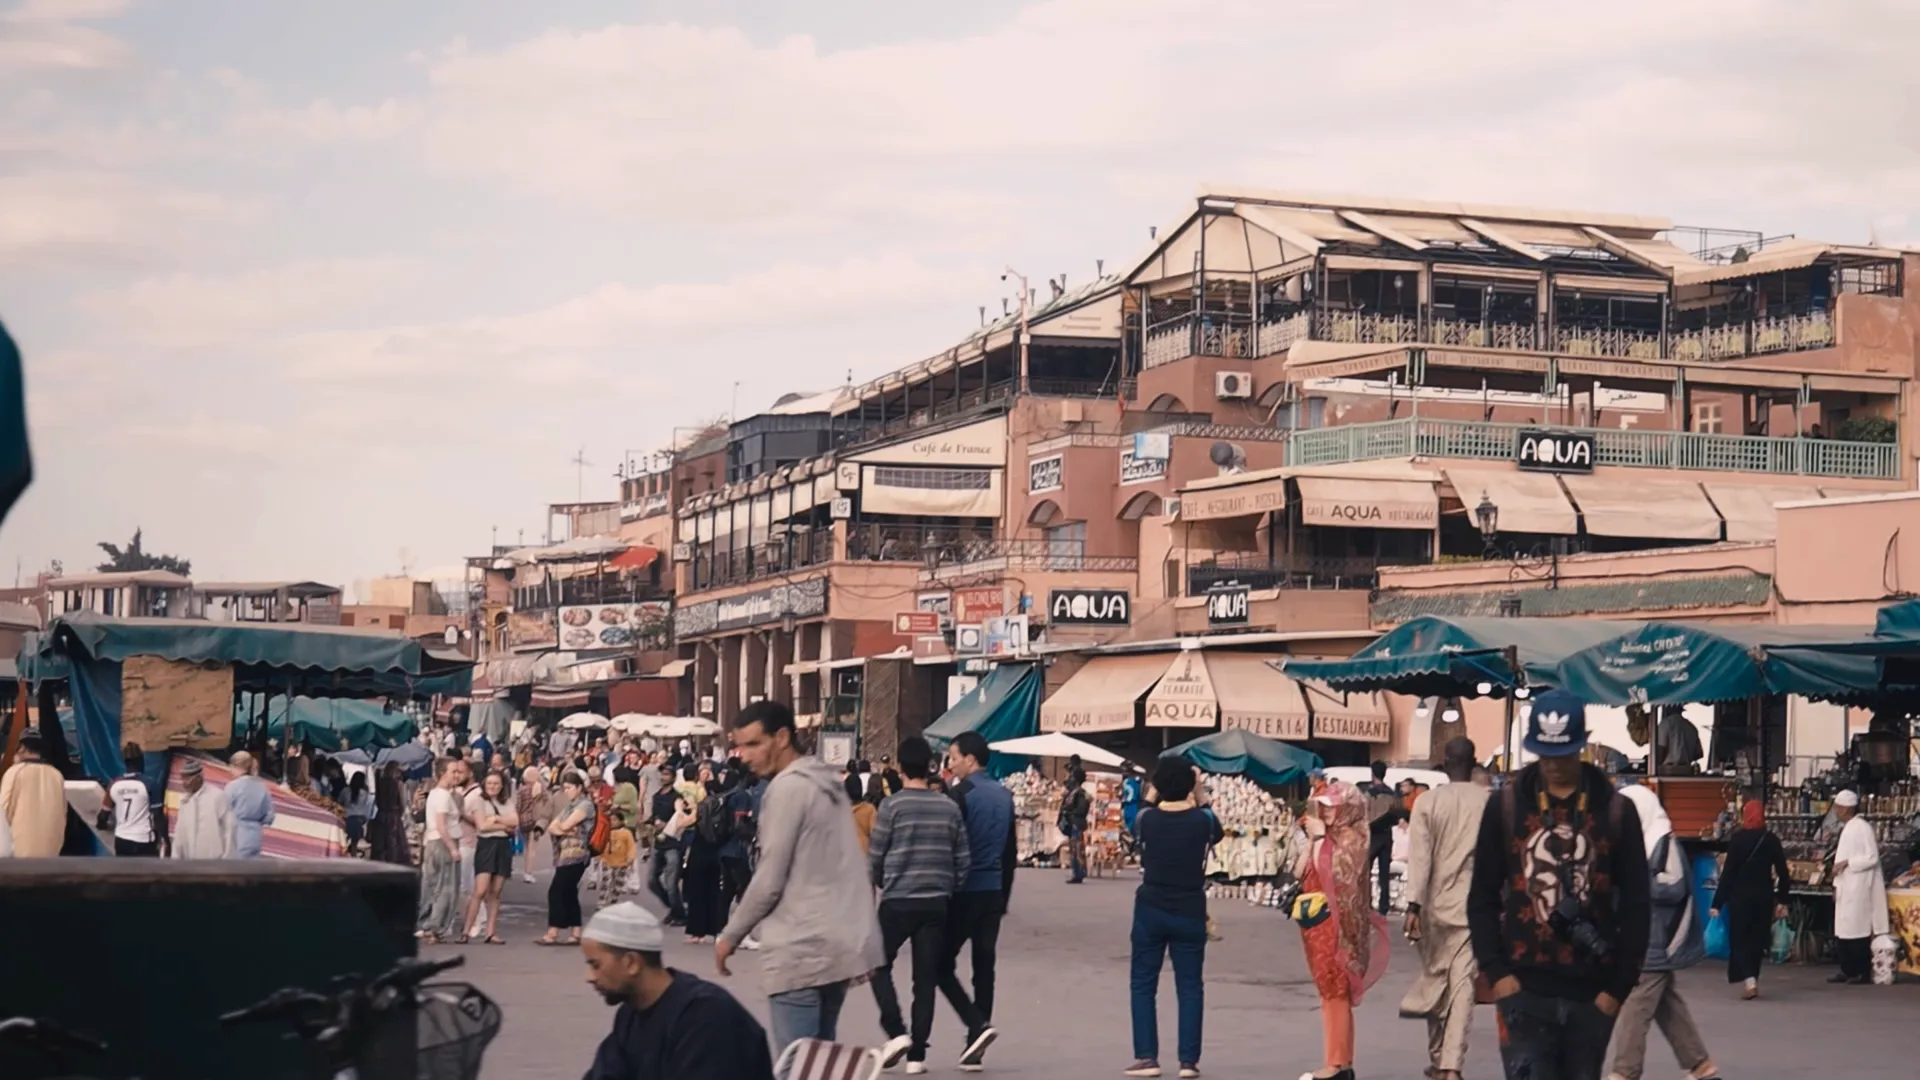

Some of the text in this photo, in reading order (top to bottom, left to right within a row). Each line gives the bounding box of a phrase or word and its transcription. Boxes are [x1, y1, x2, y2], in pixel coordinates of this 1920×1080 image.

[912, 442, 992, 457] Café de France
[1520, 437, 1590, 465] AQUA
[1331, 504, 1381, 521] AQUA
[1053, 594, 1126, 619] AQUA
[1208, 593, 1247, 618] AQUA
[1063, 712, 1091, 728] AQUA
[1147, 703, 1213, 719] AQUA
[1315, 716, 1388, 737] RESTAURANT
[123, 798, 133, 821] 7
